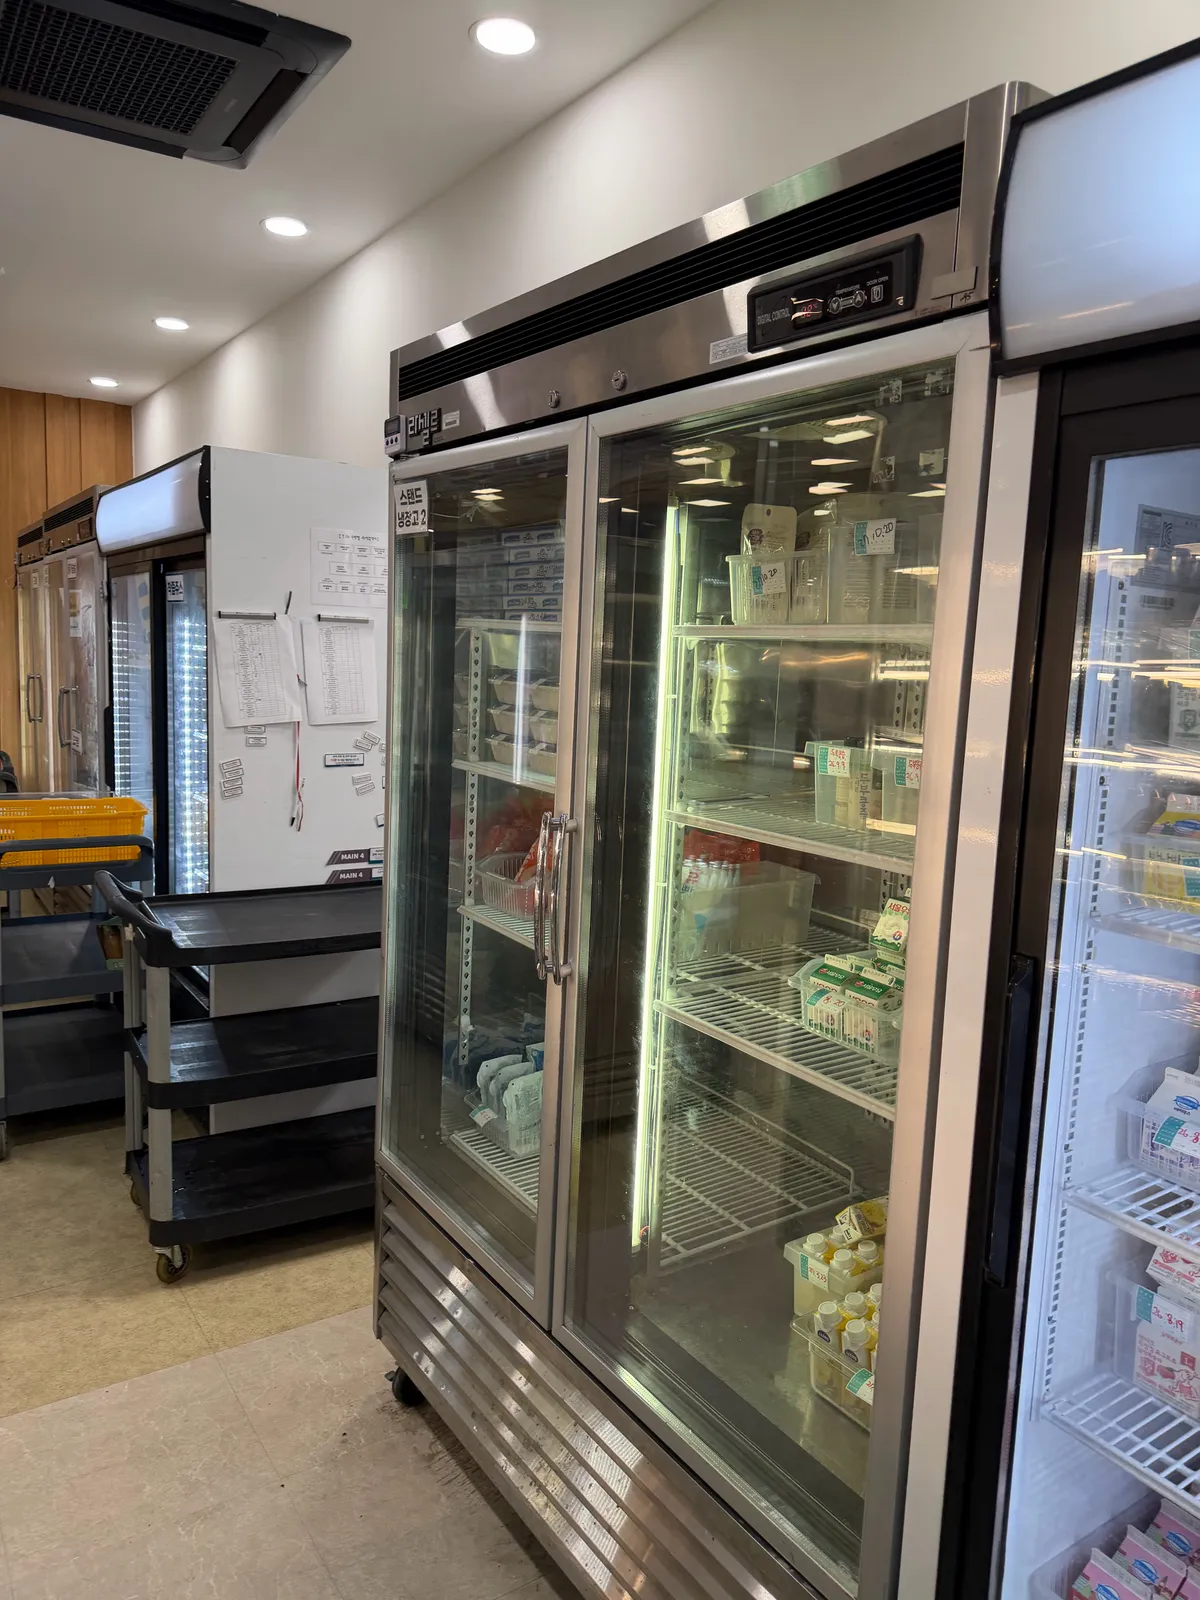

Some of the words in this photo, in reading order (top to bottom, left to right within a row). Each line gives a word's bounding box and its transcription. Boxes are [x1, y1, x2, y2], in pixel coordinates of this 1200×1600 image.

[866, 279, 878, 287] DOOR
[878, 276, 889, 284] OPEN
[757, 313, 772, 326] DIGITAL
[772, 308, 791, 321] CONTROL
[400, 488, 423, 505] 스탠드
[888, 902, 910, 915] 서울우
